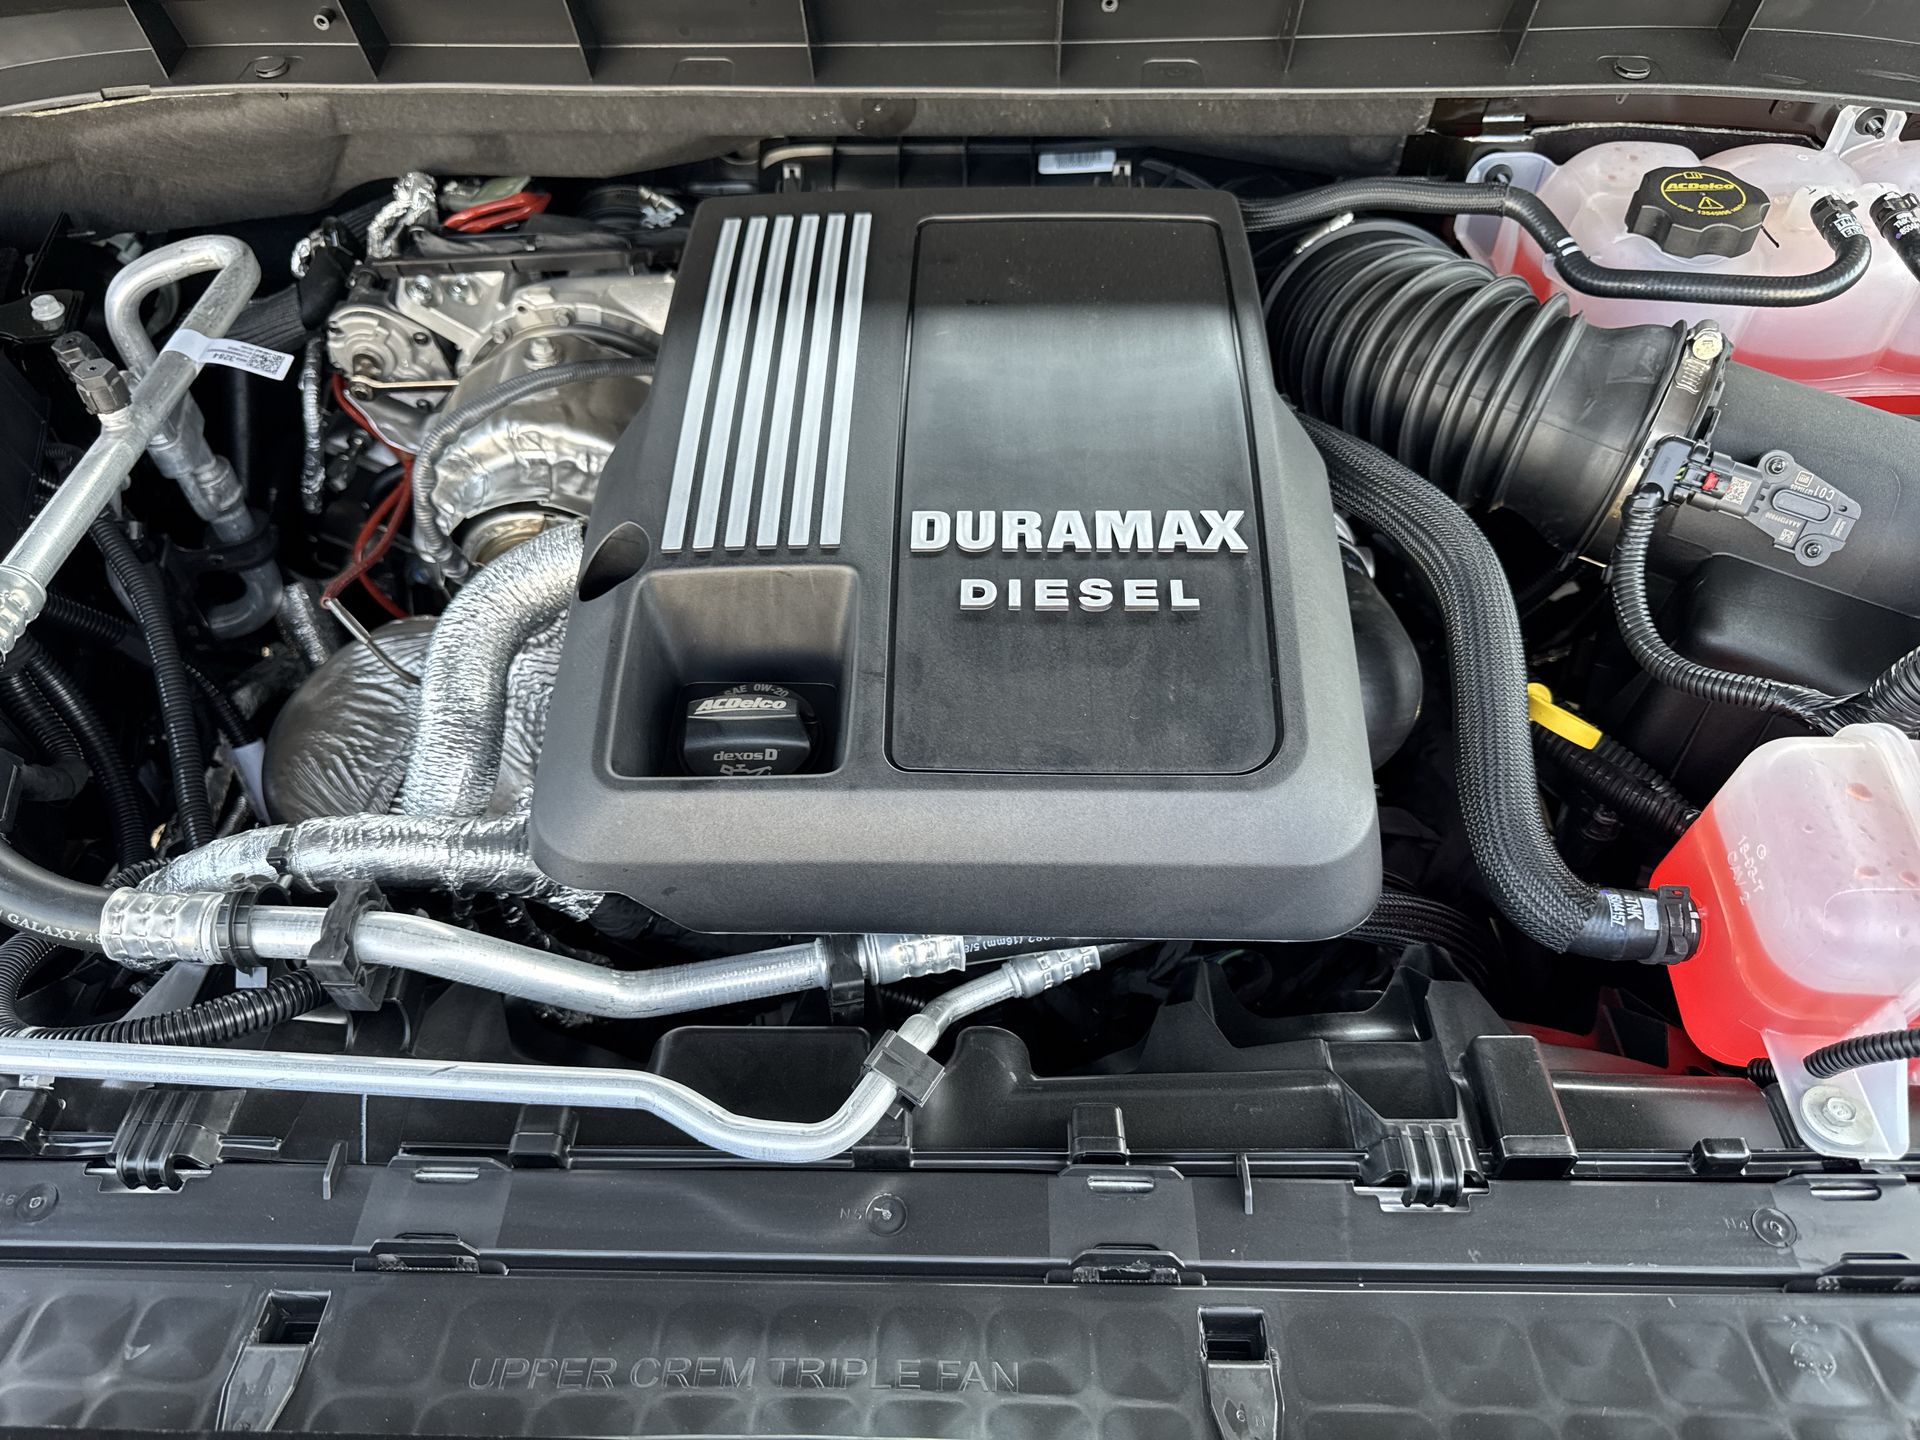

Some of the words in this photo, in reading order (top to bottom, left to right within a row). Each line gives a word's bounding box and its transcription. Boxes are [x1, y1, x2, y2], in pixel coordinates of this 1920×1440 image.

[1666, 182, 1735, 191] ACDelco
[910, 509, 1248, 553] DURAMAX
[960, 578, 1200, 612] DIESEL
[753, 683, 790, 698] 0W-20
[694, 697, 787, 713] ACDelco
[1626, 898, 1644, 921] TNK
[7, 913, 81, 941] GALAXY
[983, 936, 1023, 950] (16mm)
[467, 1356, 618, 1391] UPPER
[768, 1356, 922, 1391] TRIPLE
[936, 1360, 1020, 1394] FAN
